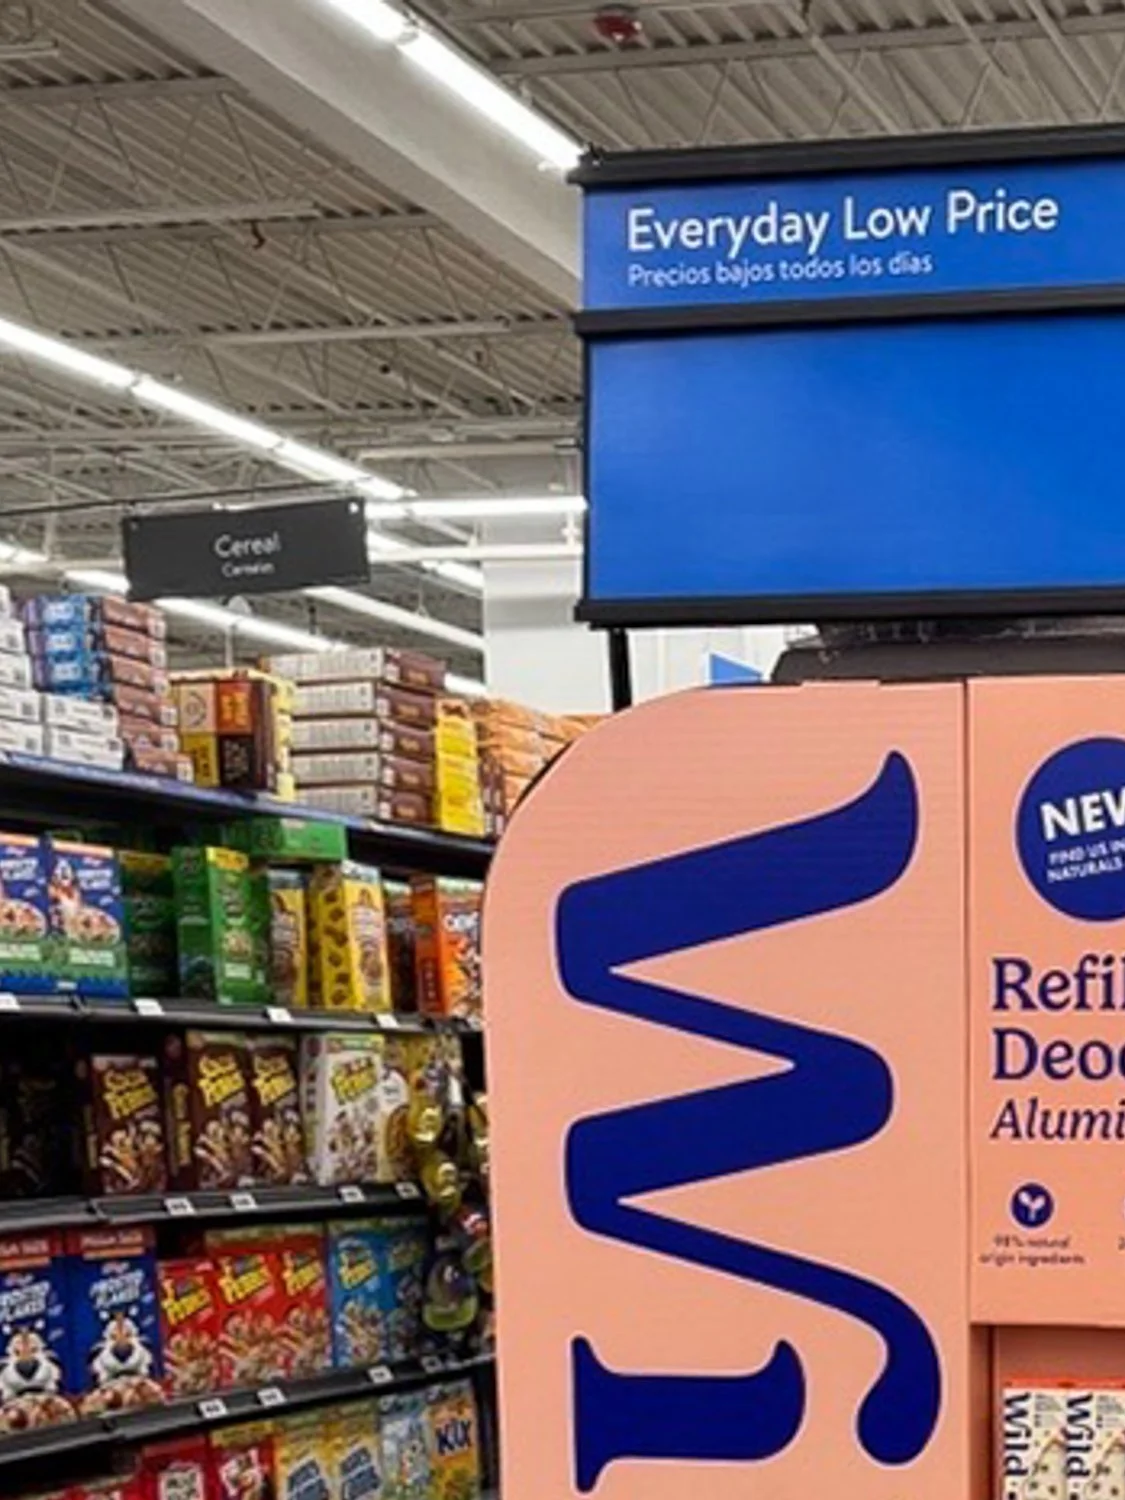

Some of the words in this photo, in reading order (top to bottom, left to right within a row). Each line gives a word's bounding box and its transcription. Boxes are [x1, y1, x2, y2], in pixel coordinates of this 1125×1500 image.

[627, 200, 829, 260] Everyday
[843, 196, 932, 242] Low
[945, 188, 1060, 236] Price
[628, 262, 711, 289] Precios
[715, 259, 774, 290] bajos
[779, 254, 845, 282] todos
[849, 253, 883, 278] los
[213, 530, 282, 558] Cereal
[1047, 856, 1124, 884] NATURALS
[1049, 846, 1086, 866] FIND
[1087, 841, 1109, 860] US
[1004, 1392, 1032, 1476] Wild
[1065, 1393, 1094, 1477] Wild
